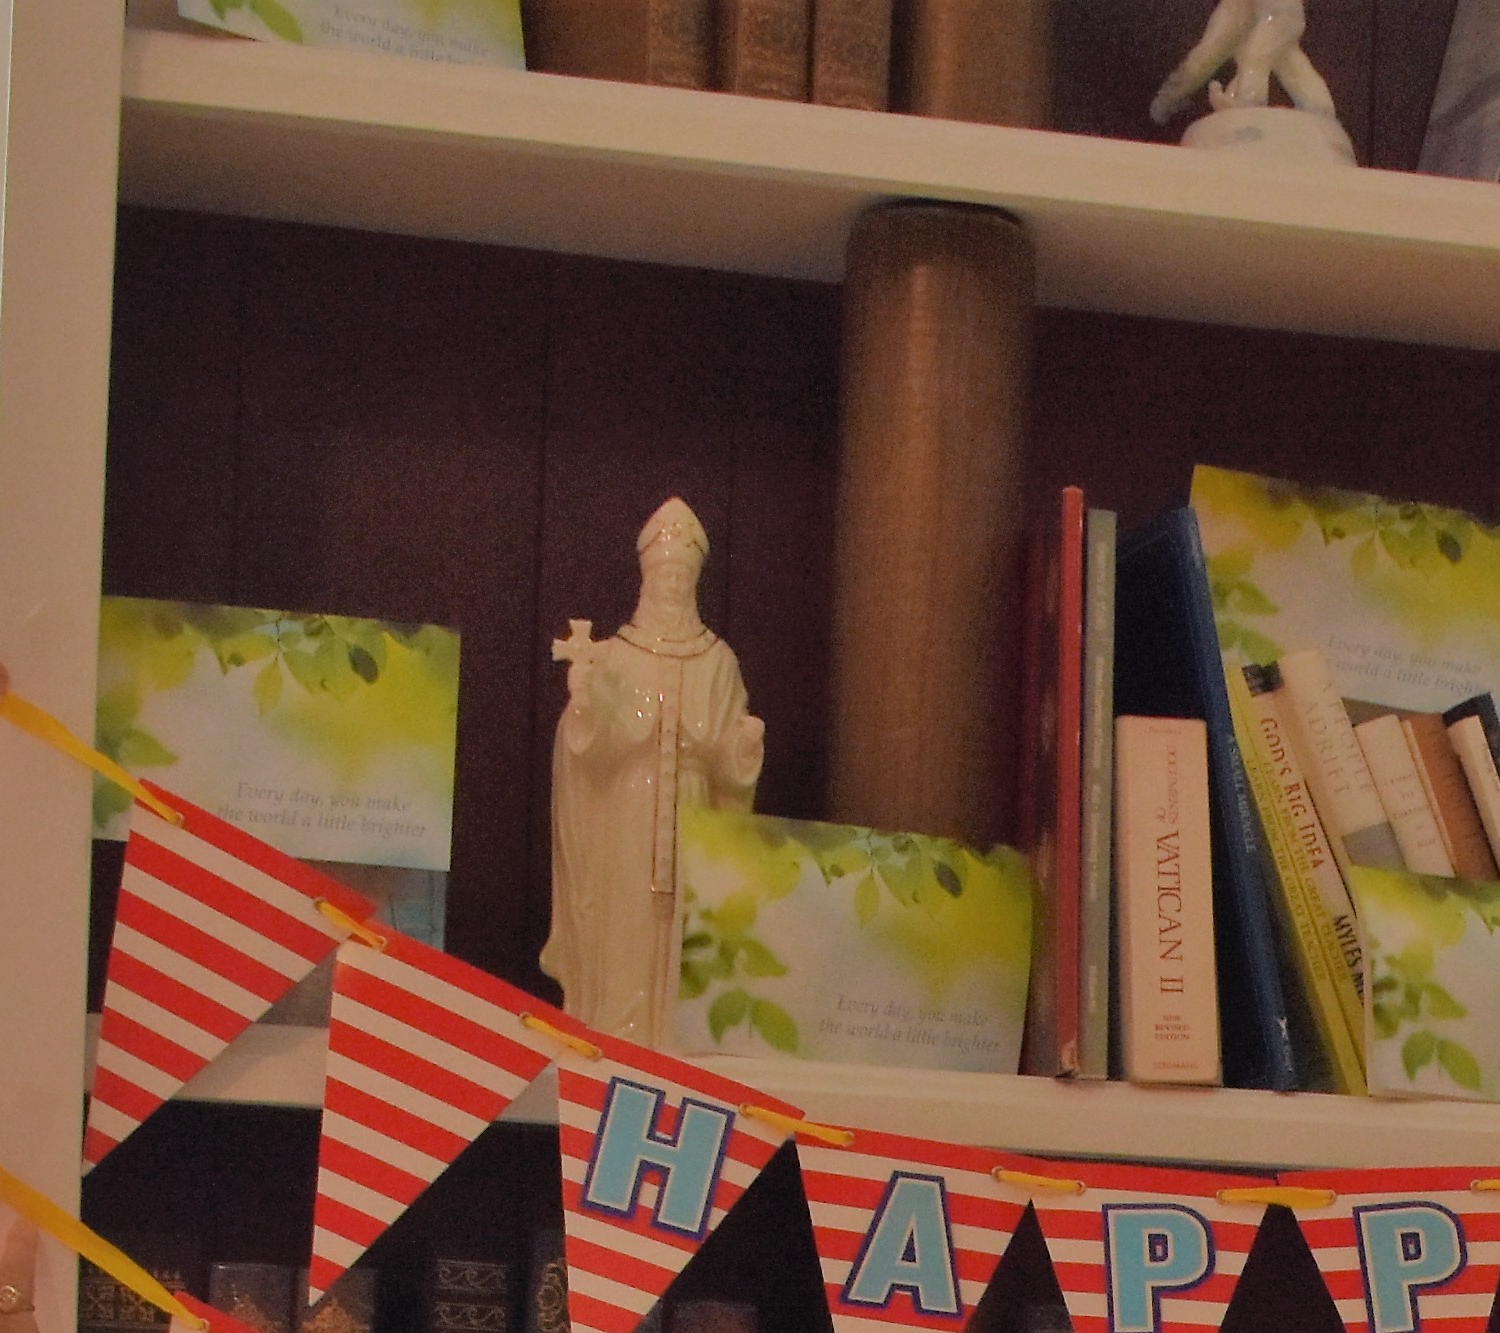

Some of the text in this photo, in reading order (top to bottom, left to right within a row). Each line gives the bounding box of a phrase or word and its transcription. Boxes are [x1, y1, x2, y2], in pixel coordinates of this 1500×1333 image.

[1165, 745, 1180, 824] DOCUMENTS
[1259, 716, 1327, 868] GOD'S BIG IDEA
[1302, 698, 1350, 795] ADRIFT
[1153, 830, 1184, 994] VATICAN II
[1331, 913, 1364, 968] MYLES
